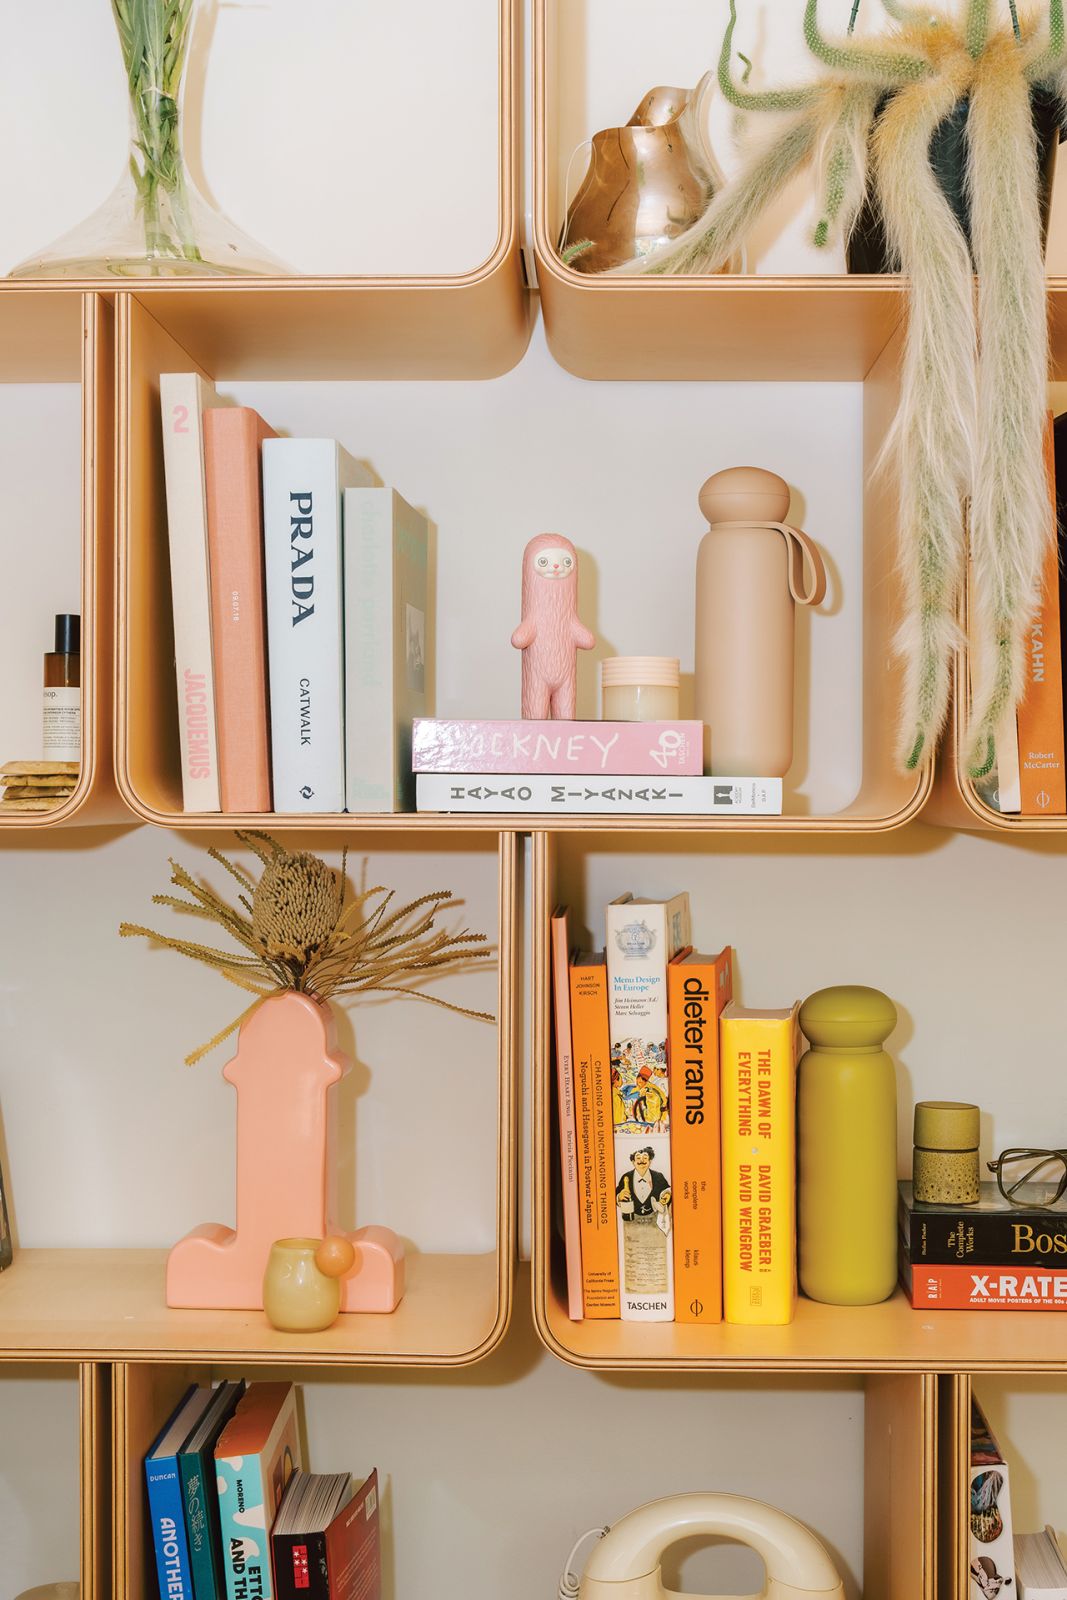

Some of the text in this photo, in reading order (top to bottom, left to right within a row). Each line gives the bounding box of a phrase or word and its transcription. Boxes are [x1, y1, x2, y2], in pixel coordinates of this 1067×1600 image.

[172, 405, 189, 433] 2
[290, 491, 314, 628] PRADA
[1031, 623, 1045, 682] KAHN
[184, 668, 210, 780] JACQUEMUS
[299, 678, 311, 746] CATWALK
[457, 732, 619, 768] OCKNEY
[649, 730, 682, 769] 40
[678, 733, 686, 765] TASCHEN
[451, 786, 683, 802] HAYAO MIYAZAKI
[614, 976, 661, 984] Menu Design
[684, 978, 709, 1125] dieter rams
[738, 1052, 751, 1136] EVERYTHING
[758, 1049, 771, 1139] THE DAWN OF
[580, 1062, 594, 1224] Noguchi and Hasegawa in Postwar Japan
[594, 1061, 608, 1224] CHANGING AND UNCHANGING THINGS
[759, 1165, 771, 1203] DAVID
[739, 1165, 753, 1272] DAVID WENGROW
[759, 1207, 771, 1265] GRAEBER
[956, 1221, 966, 1258] Complete
[966, 1227, 974, 1253] Works
[1011, 1224, 1067, 1254] Bos
[970, 1275, 1067, 1298] X-RATE
[627, 1302, 667, 1310] TASCHEN
[150, 1473, 176, 1482] DUNCAN
[236, 1480, 246, 1513] MORENO
[230, 1538, 247, 1574] AND
